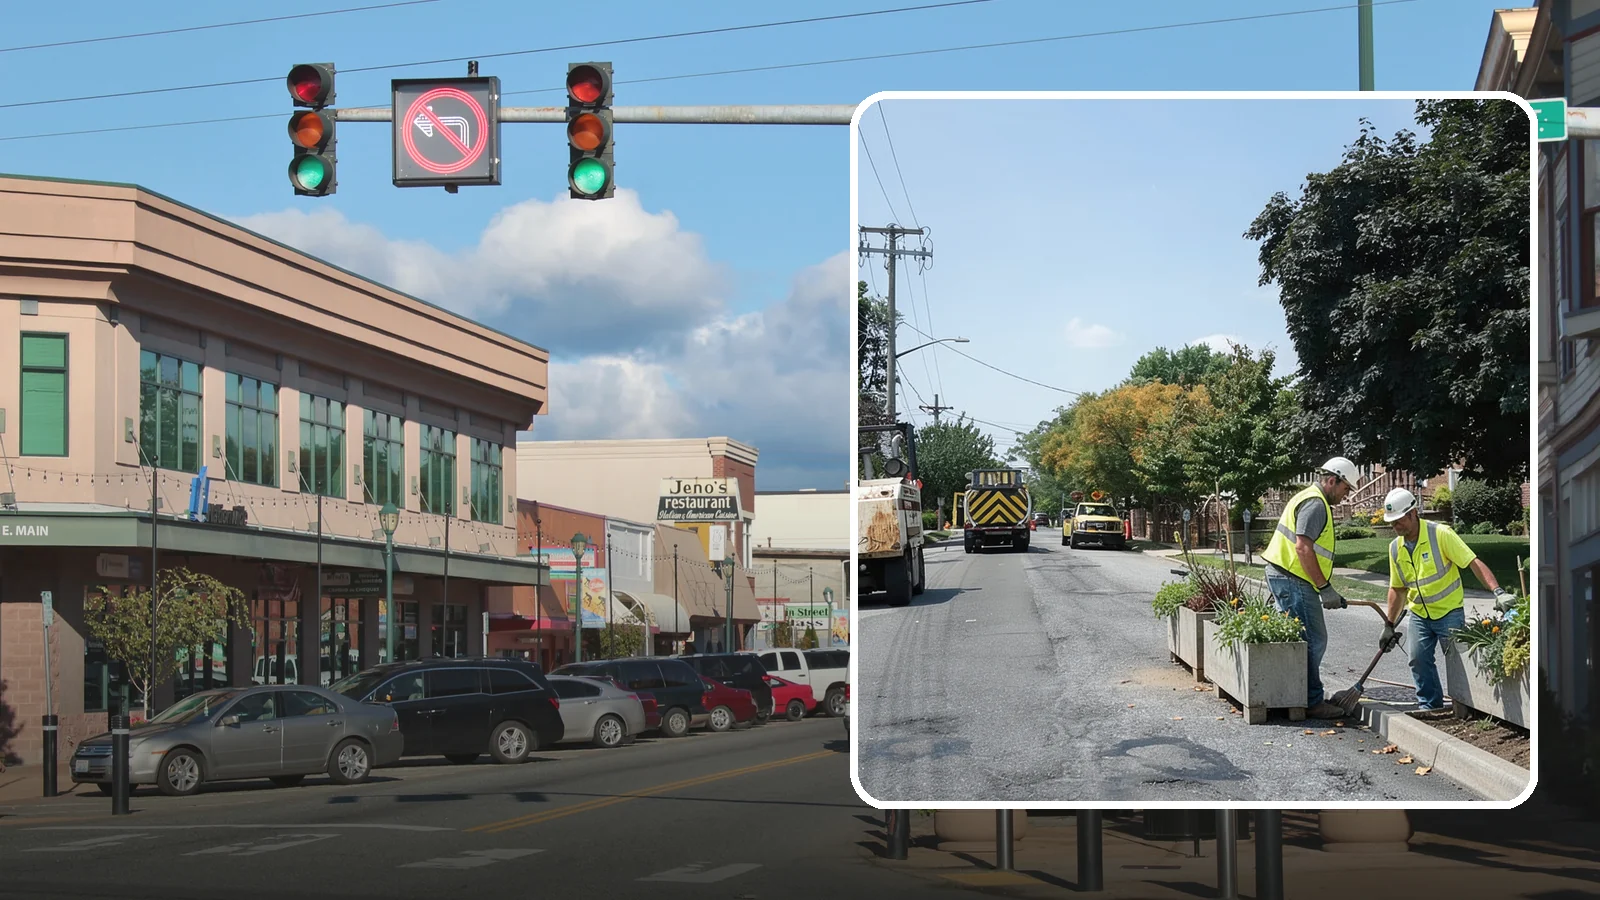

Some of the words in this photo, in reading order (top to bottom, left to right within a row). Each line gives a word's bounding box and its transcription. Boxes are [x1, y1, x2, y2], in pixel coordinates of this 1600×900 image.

[669, 479, 727, 494] Jeno's
[664, 496, 731, 509] restaurant
[658, 510, 682, 520] Italian
[686, 509, 714, 519] American
[714, 509, 737, 519] Cuisine
[2, 525, 13, 536] E.
[15, 525, 49, 536] MAIN
[797, 607, 829, 617] Street
